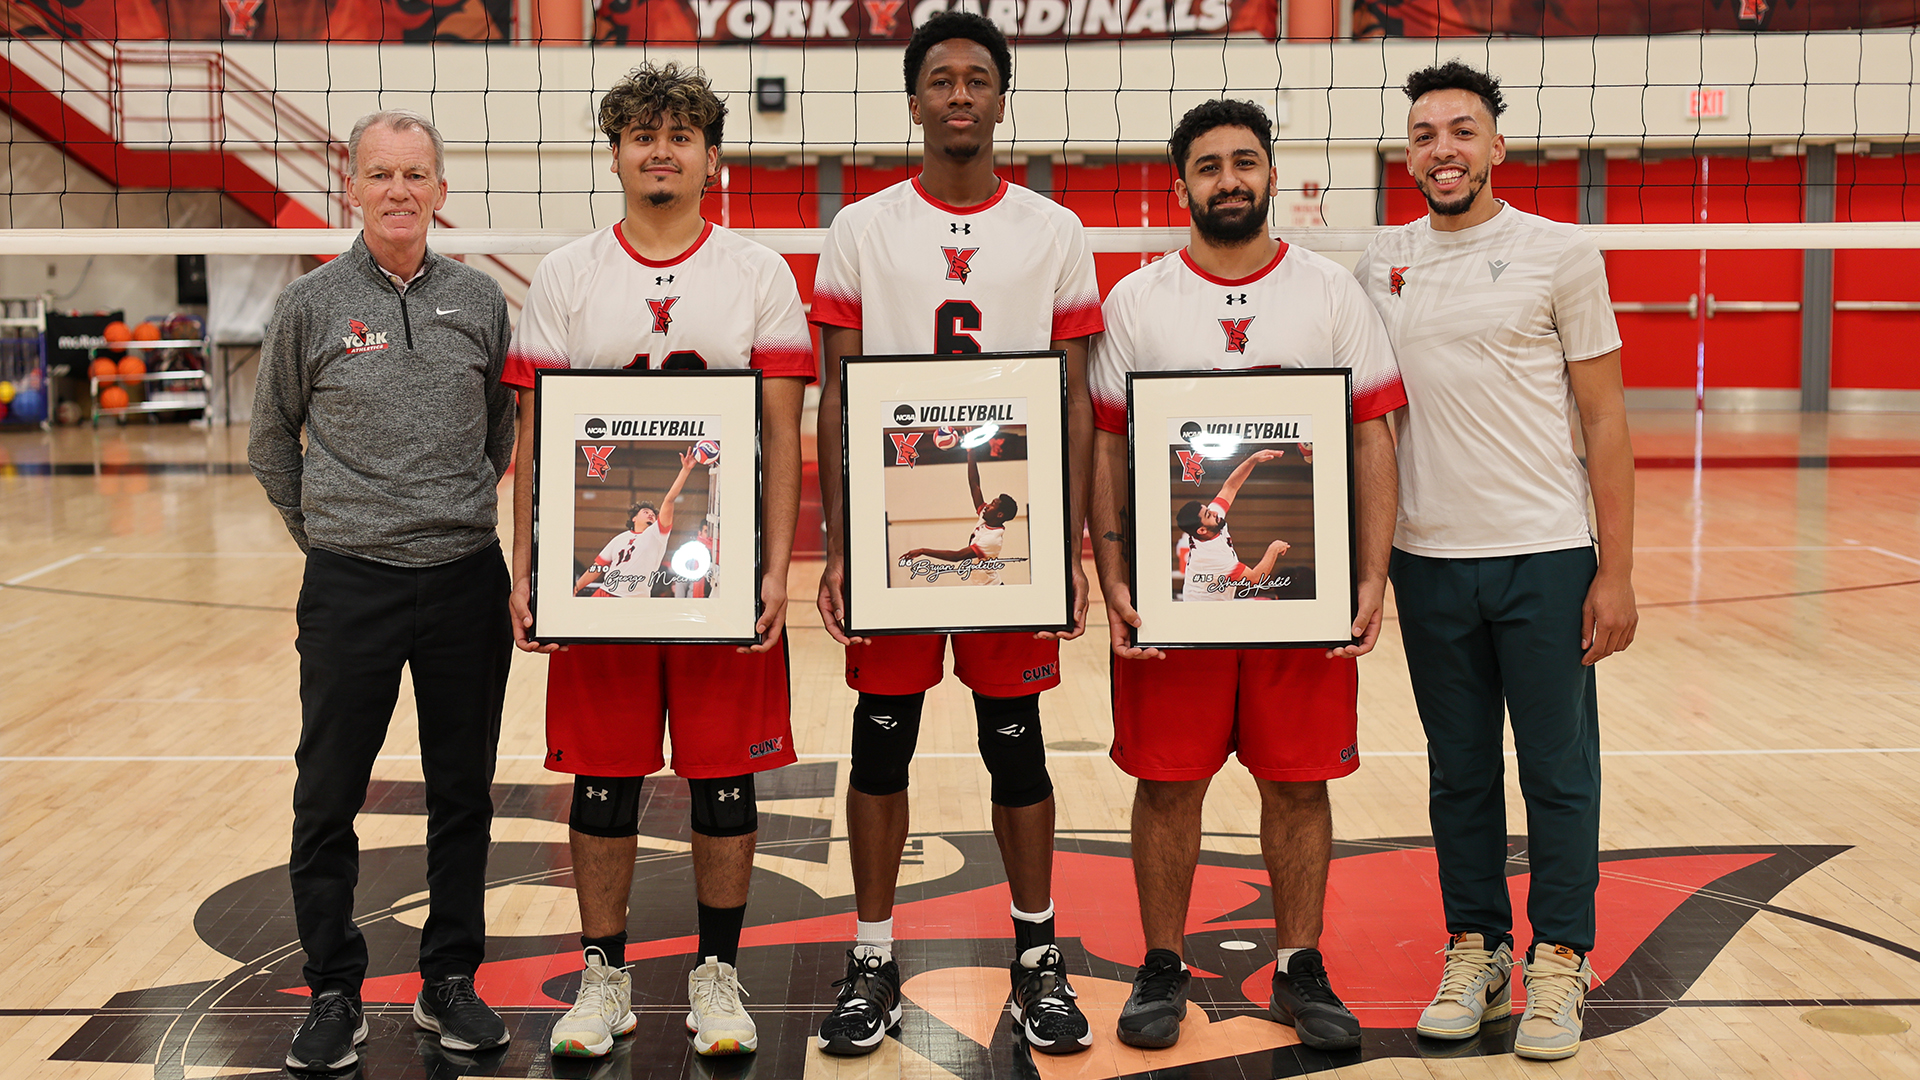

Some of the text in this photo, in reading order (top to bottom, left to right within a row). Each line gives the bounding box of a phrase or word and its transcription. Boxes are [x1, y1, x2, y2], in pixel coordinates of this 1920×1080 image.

[689, 0, 851, 39] YORK
[1690, 90, 1726, 117] EXIT
[934, 299, 982, 354] 6
[341, 331, 388, 349] YORK
[350, 344, 384, 354] ATHLETICS
[920, 404, 1014, 423] VOLLEYBALL
[611, 420, 706, 437] VOLLEYBALL
[589, 565, 610, 573] #10
[604, 569, 647, 592] George
[899, 559, 913, 568] #6
[910, 559, 956, 583] Bryan
[1193, 574, 1213, 583] #15
[1207, 575, 1251, 598] Shady
[1022, 661, 1057, 680] CUNY
[749, 736, 783, 756] CUNY
